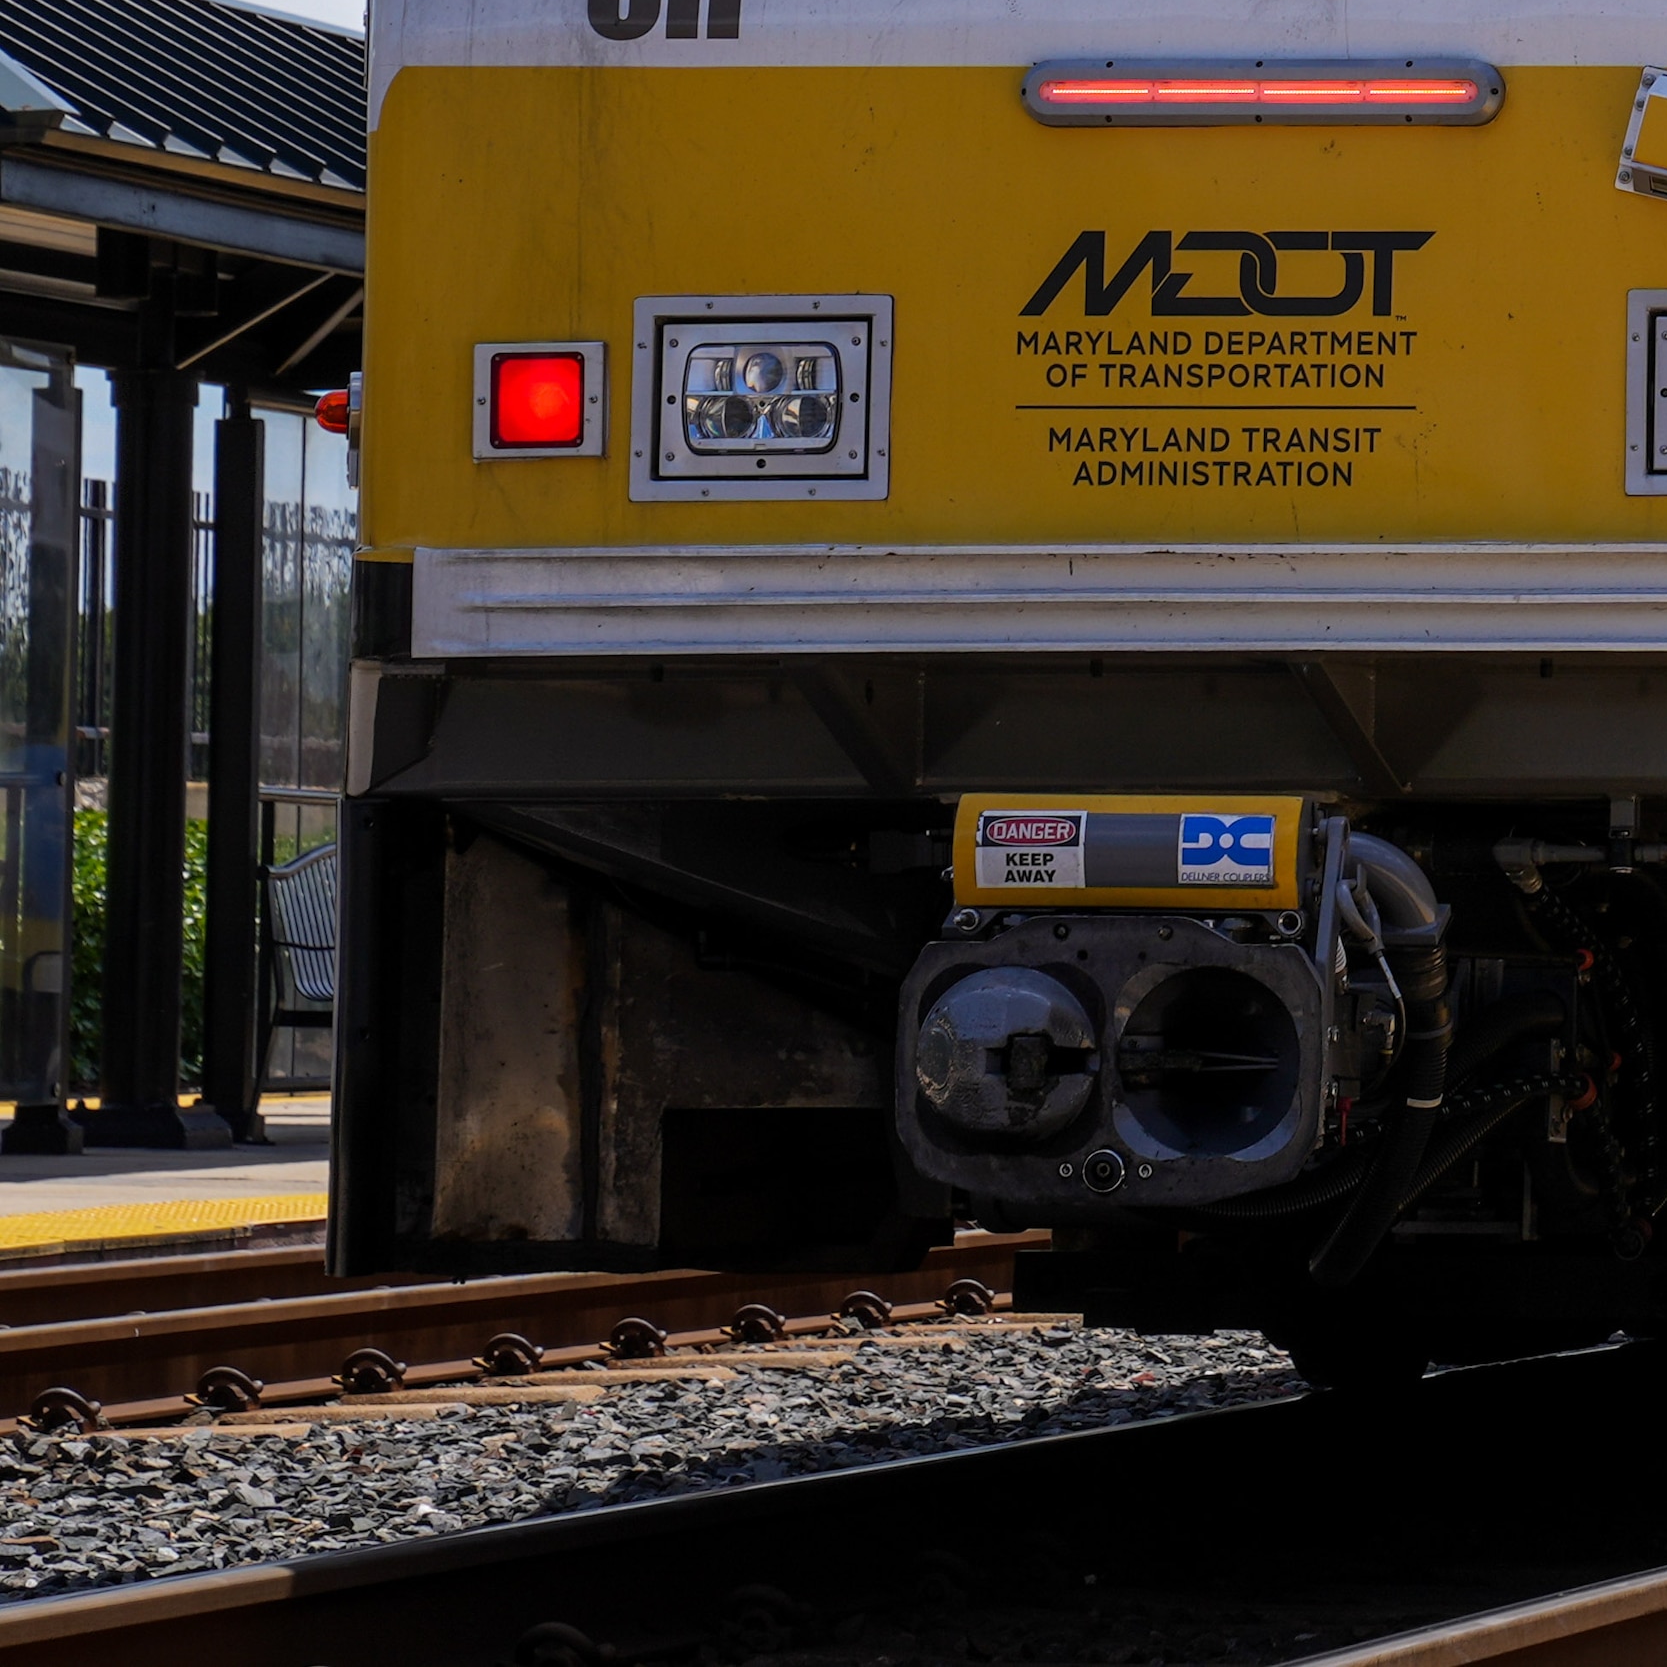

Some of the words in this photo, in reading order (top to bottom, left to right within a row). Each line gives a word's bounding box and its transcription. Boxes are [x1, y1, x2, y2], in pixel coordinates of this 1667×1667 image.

[1018, 229, 1437, 317] MDOT
[1016, 330, 1193, 356] MARYLAND
[1203, 330, 1418, 356] DEPARTMENT
[1045, 363, 1088, 389] OF
[1099, 363, 1385, 388] TRANSPORTATION
[1048, 427, 1231, 453] MARYLAND
[1242, 427, 1382, 453] TRANSIT
[1072, 460, 1354, 487] ADMINISTRATION
[992, 822, 1071, 840] DANGER
[1005, 852, 1054, 867] KEEP
[1004, 869, 1057, 883] AWAY
[1181, 871, 1220, 882] DELLNER
